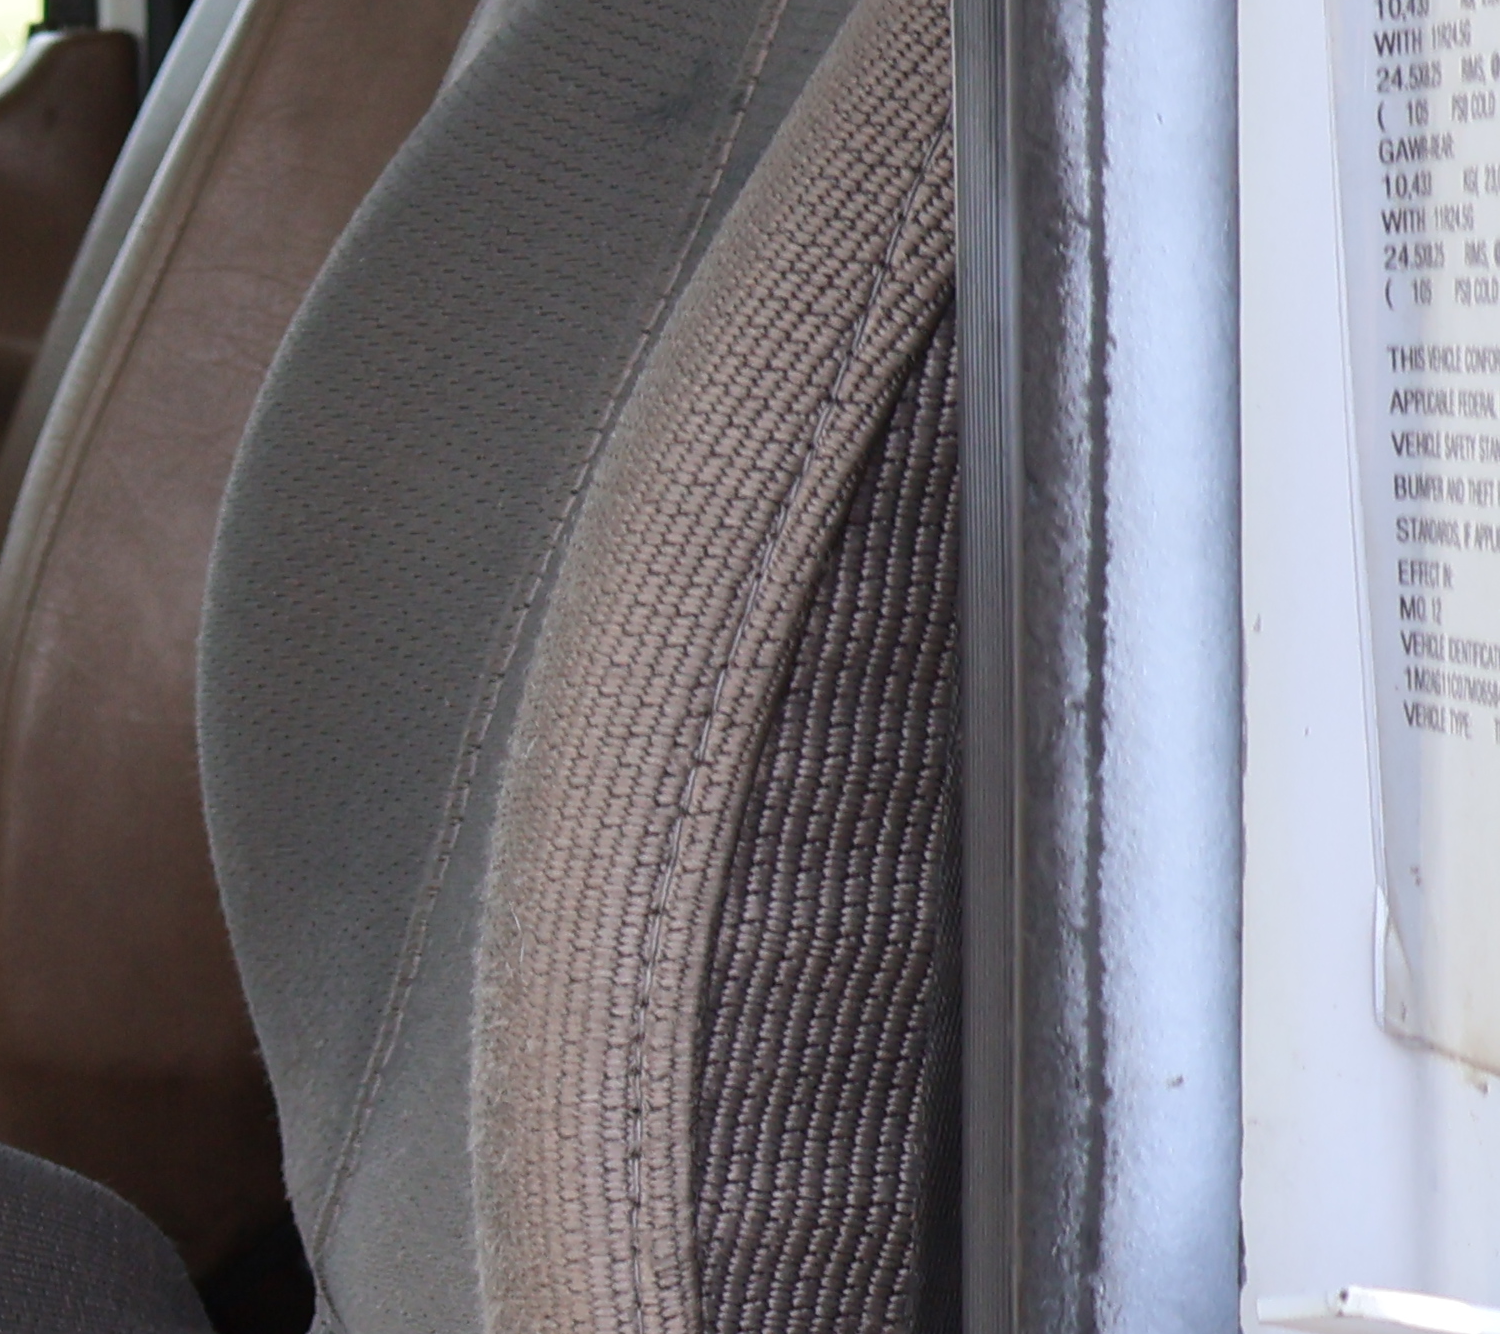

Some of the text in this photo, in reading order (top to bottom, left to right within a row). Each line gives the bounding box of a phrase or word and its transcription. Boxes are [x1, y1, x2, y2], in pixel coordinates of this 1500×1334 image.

[1374, 29, 1422, 57] WITH
[1378, 103, 1385, 132] (
[1407, 99, 1428, 126] 105
[1471, 90, 1495, 120] COLD
[1381, 208, 1425, 234] WITH
[1385, 278, 1392, 309] (
[1412, 278, 1431, 304] 105
[1474, 276, 1499, 304] COLD
[1387, 344, 1425, 373] THIS
[1428, 346, 1462, 374] VEHICLE
[1390, 388, 1496, 419] APPLICABLE FEDERAL
[1391, 430, 1442, 460] VEHICLE
[1445, 431, 1476, 461] SAFETY
[1394, 474, 1445, 503] BUMPER
[1447, 476, 1465, 505] AND
[1398, 558, 1440, 588] EFFECT
[1432, 597, 1442, 625] 12
[1400, 629, 1445, 665] VEHICLE
[1403, 699, 1446, 732] VEHICLE
